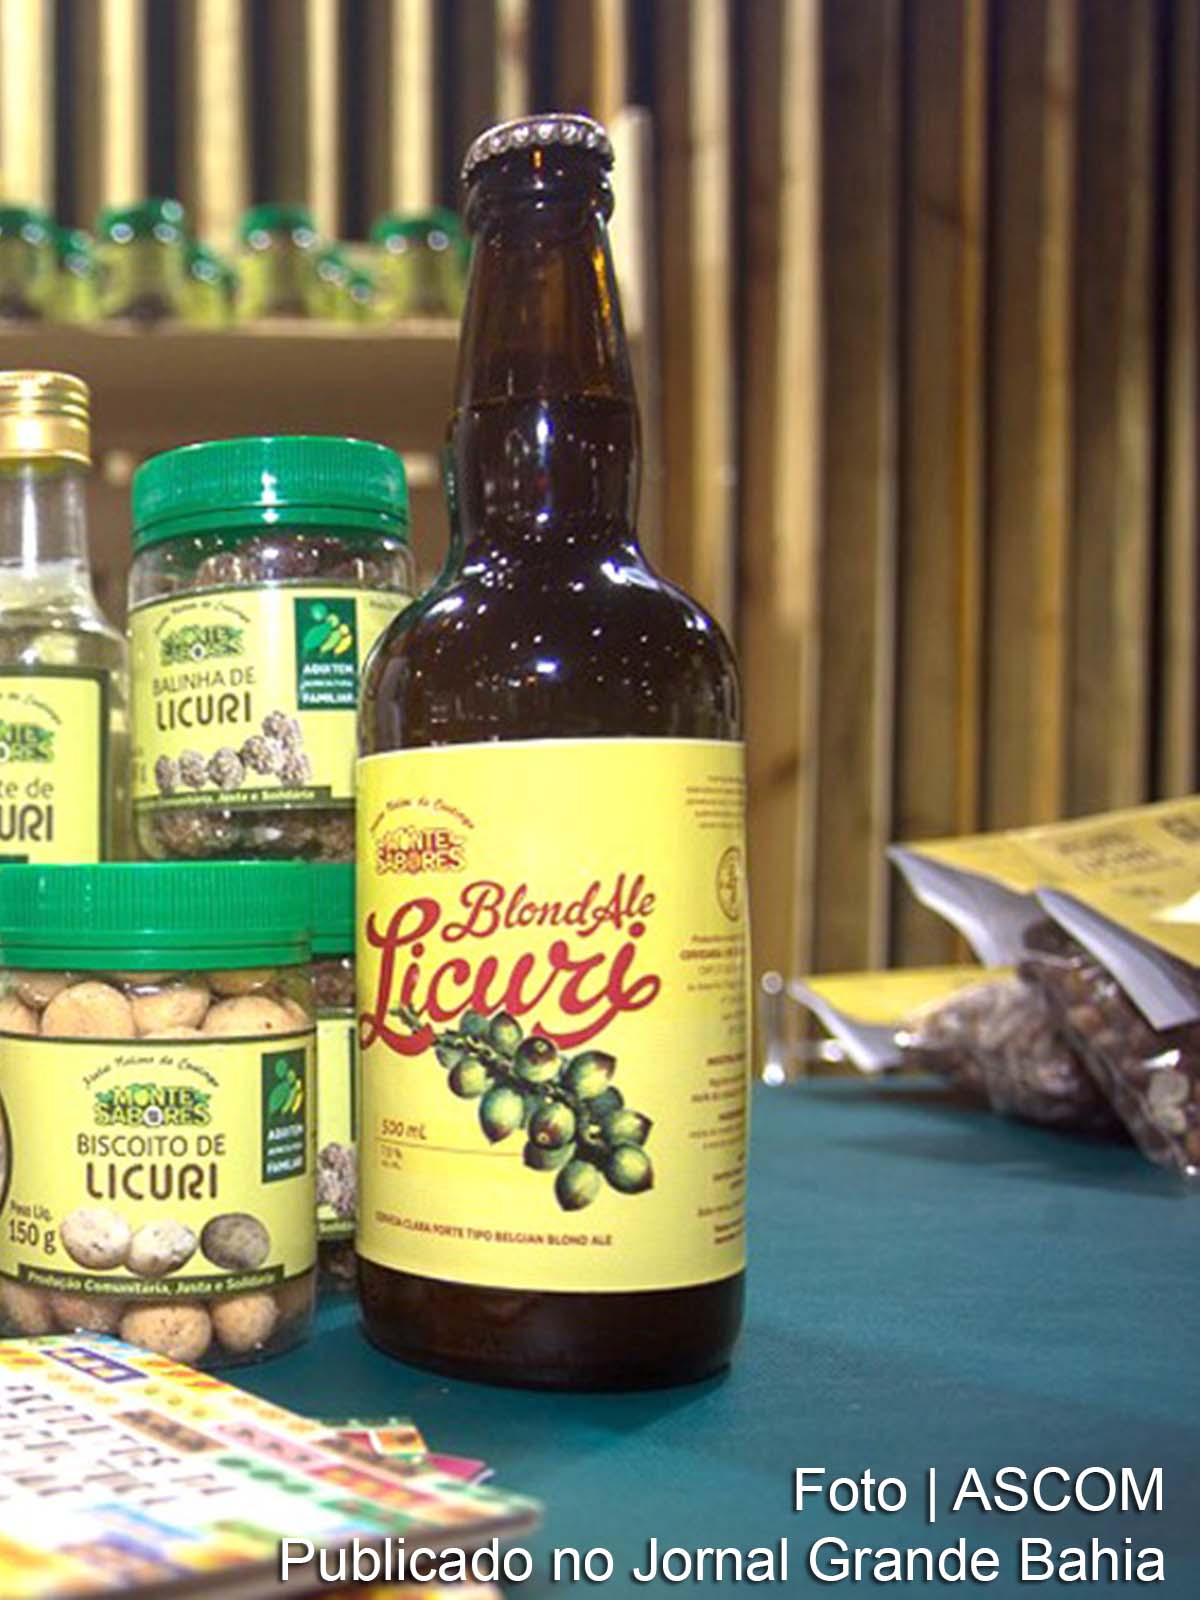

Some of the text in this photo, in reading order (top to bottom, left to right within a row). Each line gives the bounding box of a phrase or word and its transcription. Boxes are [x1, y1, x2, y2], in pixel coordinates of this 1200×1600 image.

[153, 666, 256, 697] BALINHA DE
[157, 691, 252, 732] LICURI
[26, 778, 54, 799] de
[359, 897, 662, 1057] Licuri
[93, 1103, 212, 1128] SABORES
[77, 1132, 227, 1157] BISCOITO DE
[86, 1161, 218, 1201] LICURI
[9, 1218, 57, 1256] 150 g
[467, 1227, 494, 1242] TIPO
[495, 1231, 544, 1246] BELGIAN
[591, 1233, 614, 1247] ALE
